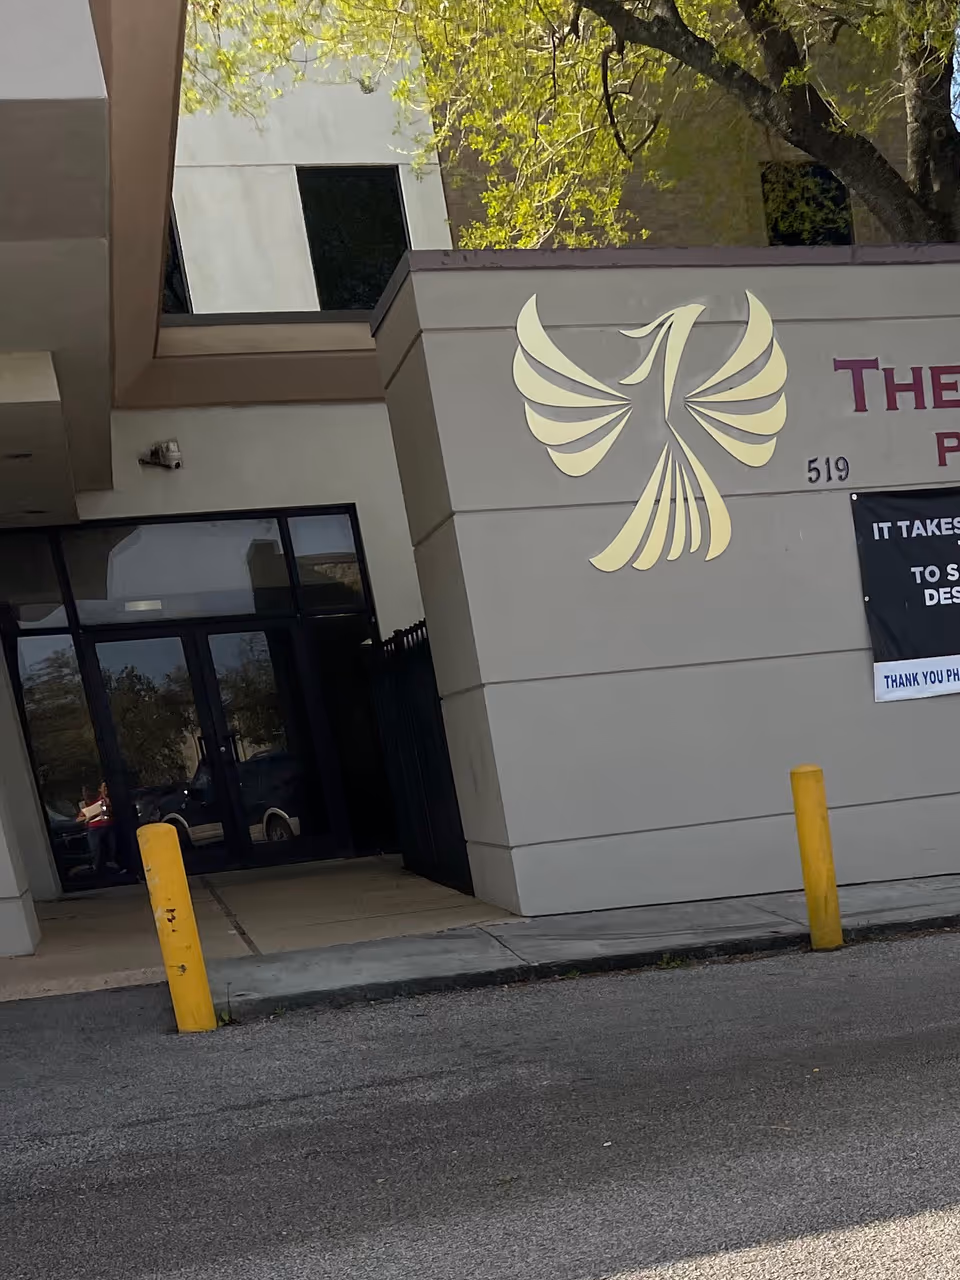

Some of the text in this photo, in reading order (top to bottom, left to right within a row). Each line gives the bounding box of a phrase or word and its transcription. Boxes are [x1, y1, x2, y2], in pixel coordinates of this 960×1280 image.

[807, 456, 850, 484] 519
[872, 522, 892, 540] IT
[911, 565, 940, 583] TO
[884, 672, 920, 689] THANK
[922, 669, 944, 685] YOU
